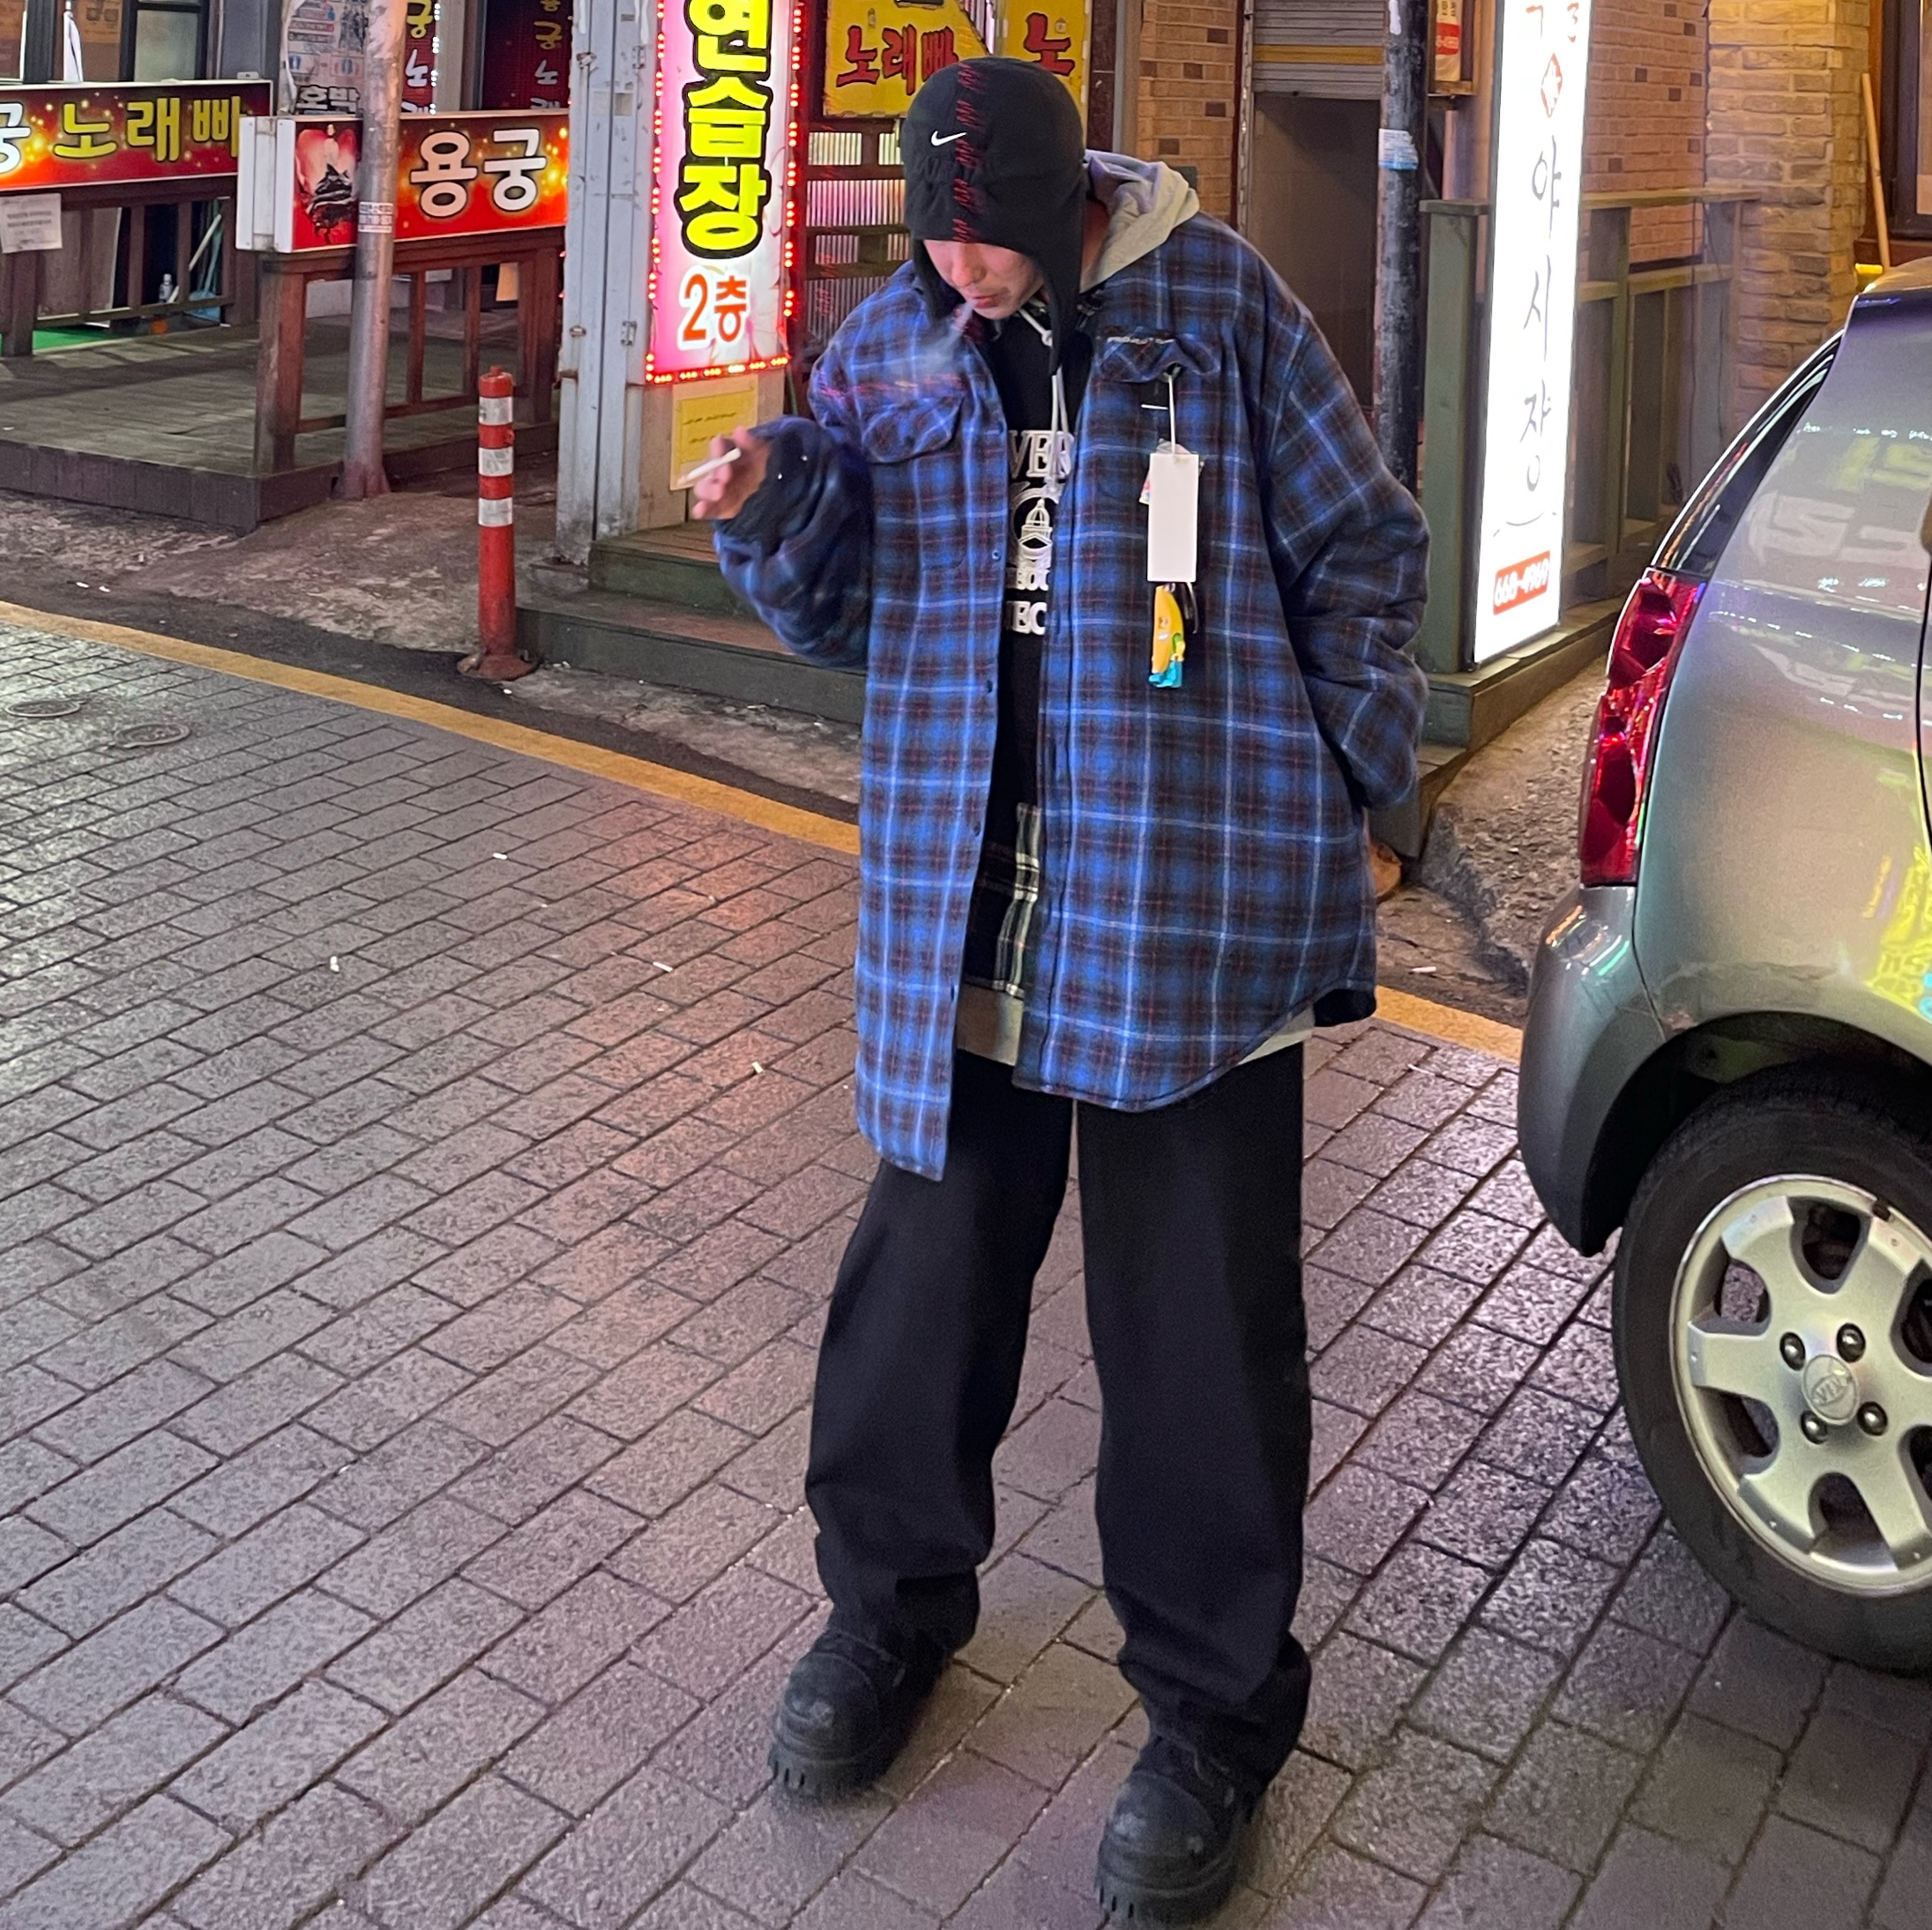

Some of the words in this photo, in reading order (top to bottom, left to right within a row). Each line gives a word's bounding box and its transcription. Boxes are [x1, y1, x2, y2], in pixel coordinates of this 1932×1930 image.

[836, 25, 959, 96] 노래빠
[1024, 12, 1076, 77] 노
[53, 95, 242, 161] 노래빠
[680, 0, 769, 250] 연습장
[410, 129, 547, 217] 용궁
[682, 273, 749, 343] 2층
[1520, 135, 1563, 492] 야시장
